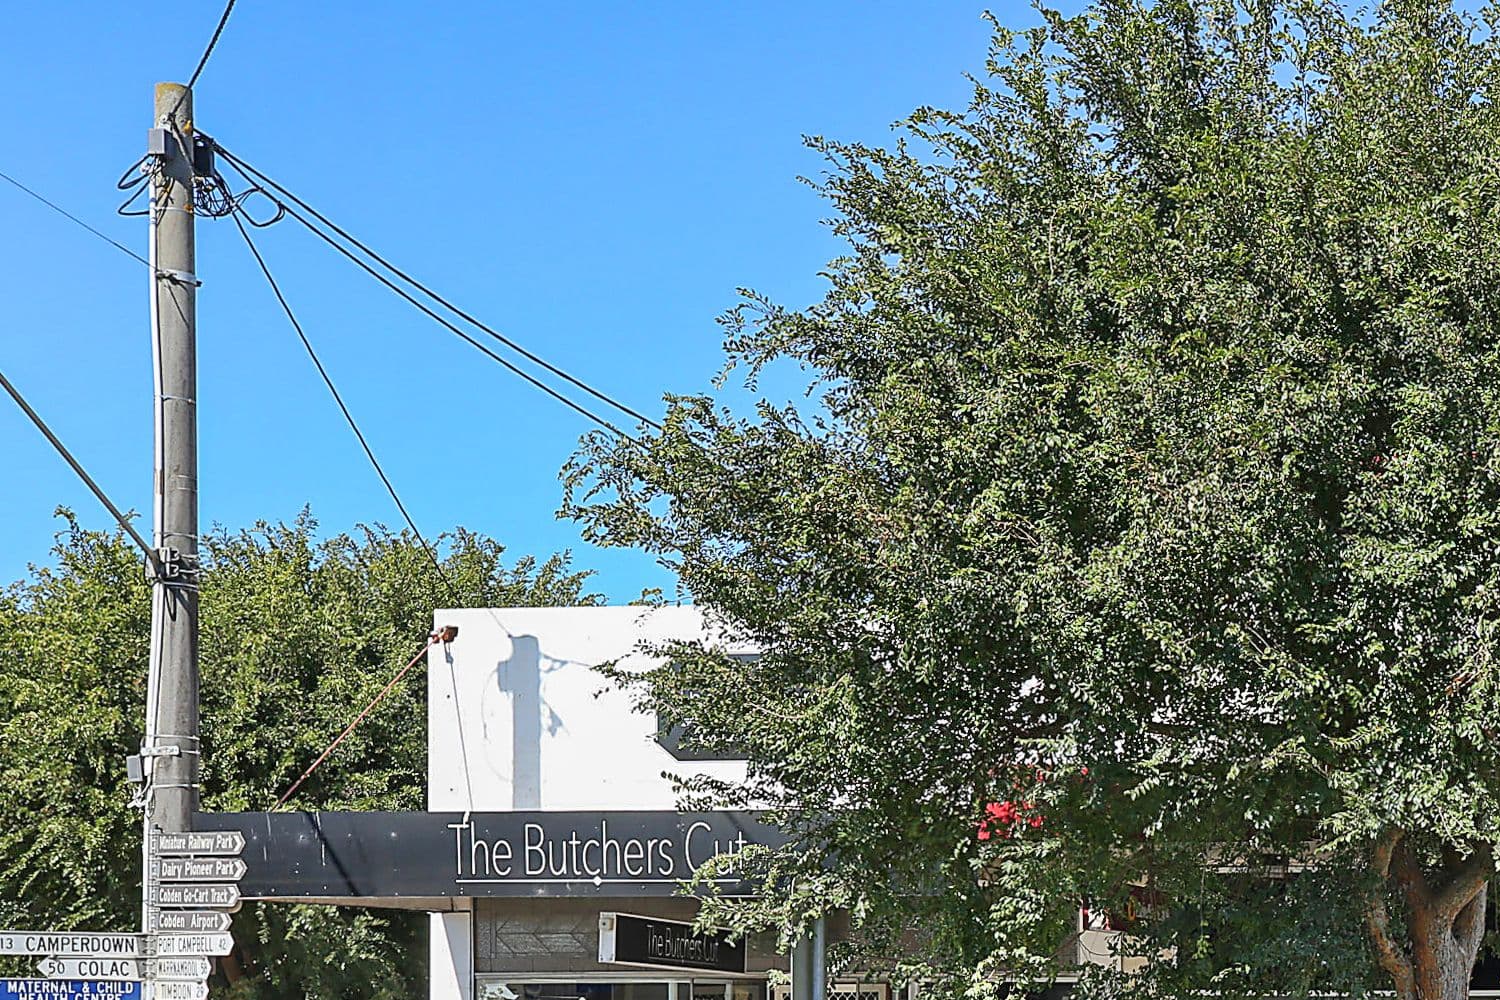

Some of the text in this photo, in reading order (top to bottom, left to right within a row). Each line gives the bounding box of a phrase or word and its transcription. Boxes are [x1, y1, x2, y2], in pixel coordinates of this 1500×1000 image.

[160, 834, 234, 852] Miniature Railway Park
[447, 820, 749, 876] The Butchers Cut
[162, 861, 234, 879] Dairy Pioneer Park
[160, 888, 182, 903] Cobden
[183, 887, 209, 903] Go-Cart
[160, 913, 219, 933] Cobden Airport
[0, 936, 136, 953] 13 CAMPERDOWN
[158, 937, 176, 953] PORT
[177, 936, 214, 953] CAMPBELL
[646, 923, 720, 962] The Butchers Cut
[48, 961, 130, 977] 50 COLAC
[7, 980, 134, 994] MATERNAL & CHILD
[161, 983, 192, 1000] TIMBOON
